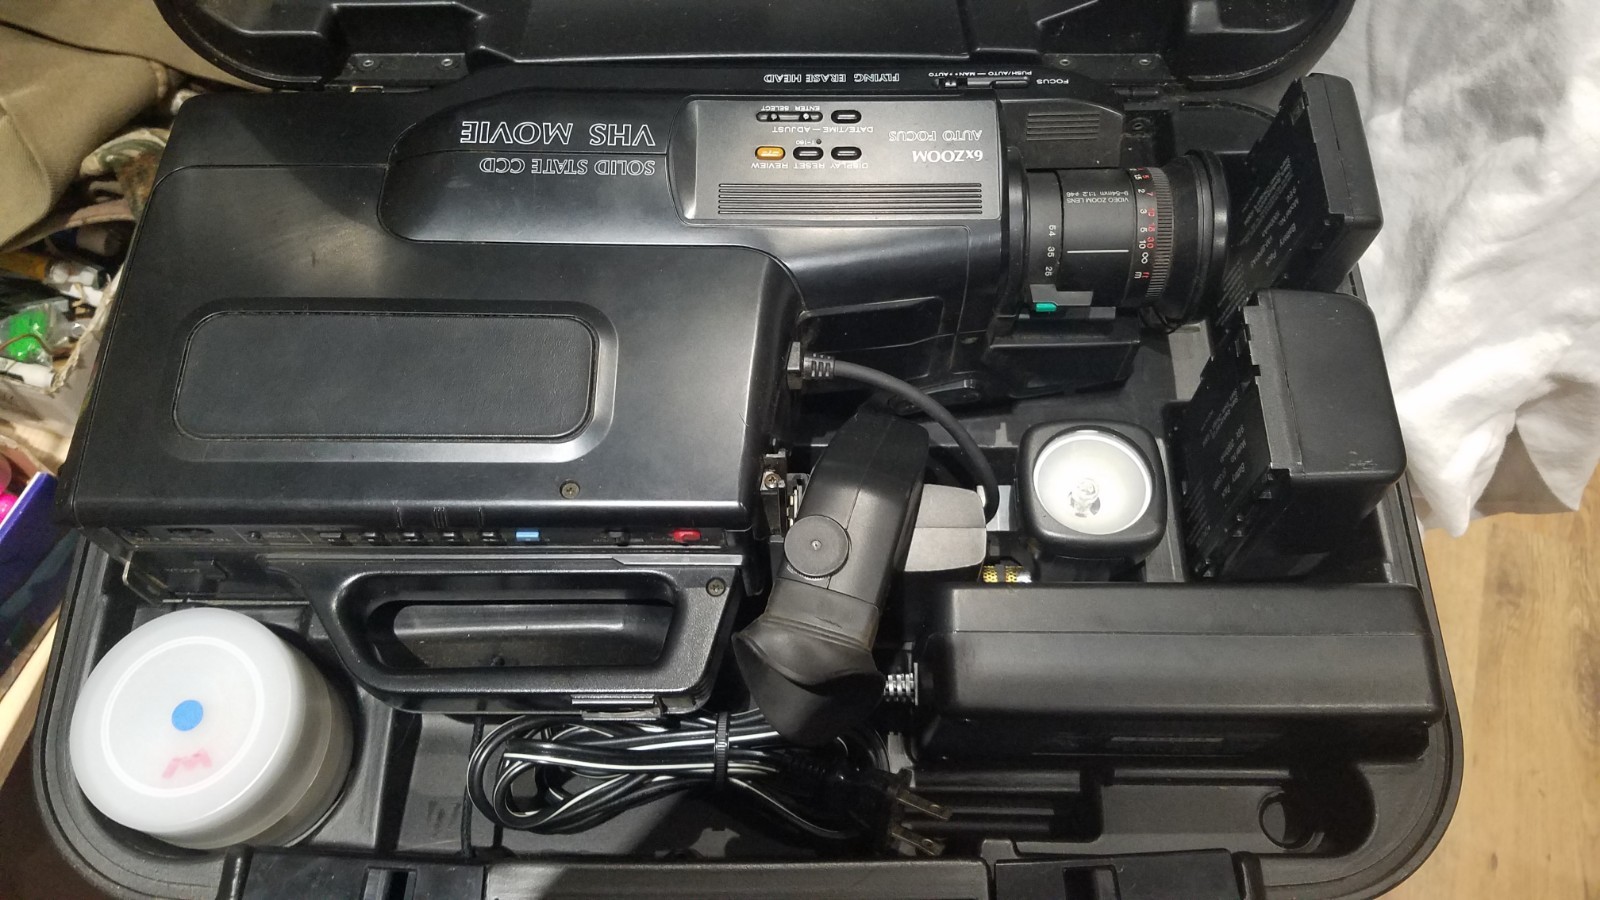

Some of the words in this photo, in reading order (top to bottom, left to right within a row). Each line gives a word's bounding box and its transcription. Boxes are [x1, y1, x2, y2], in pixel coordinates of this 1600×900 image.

[763, 73, 802, 83] HEAD
[805, 73, 847, 83] ERASE
[853, 73, 900, 82] FLYING
[459, 121, 574, 145] MOVIE
[588, 123, 656, 147] VHS
[888, 130, 937, 142] FOCUS
[942, 130, 983, 142] AUTO
[912, 149, 984, 163] 6xZOOM
[479, 157, 526, 174] CCD
[531, 158, 589, 175] STATE
[594, 159, 656, 176] SOLID
[1048, 224, 1057, 237] 54
[1138, 240, 1147, 249] 10
[1147, 236, 1154, 249] 30
[1047, 246, 1056, 258] 35
[1134, 271, 1142, 279] m
